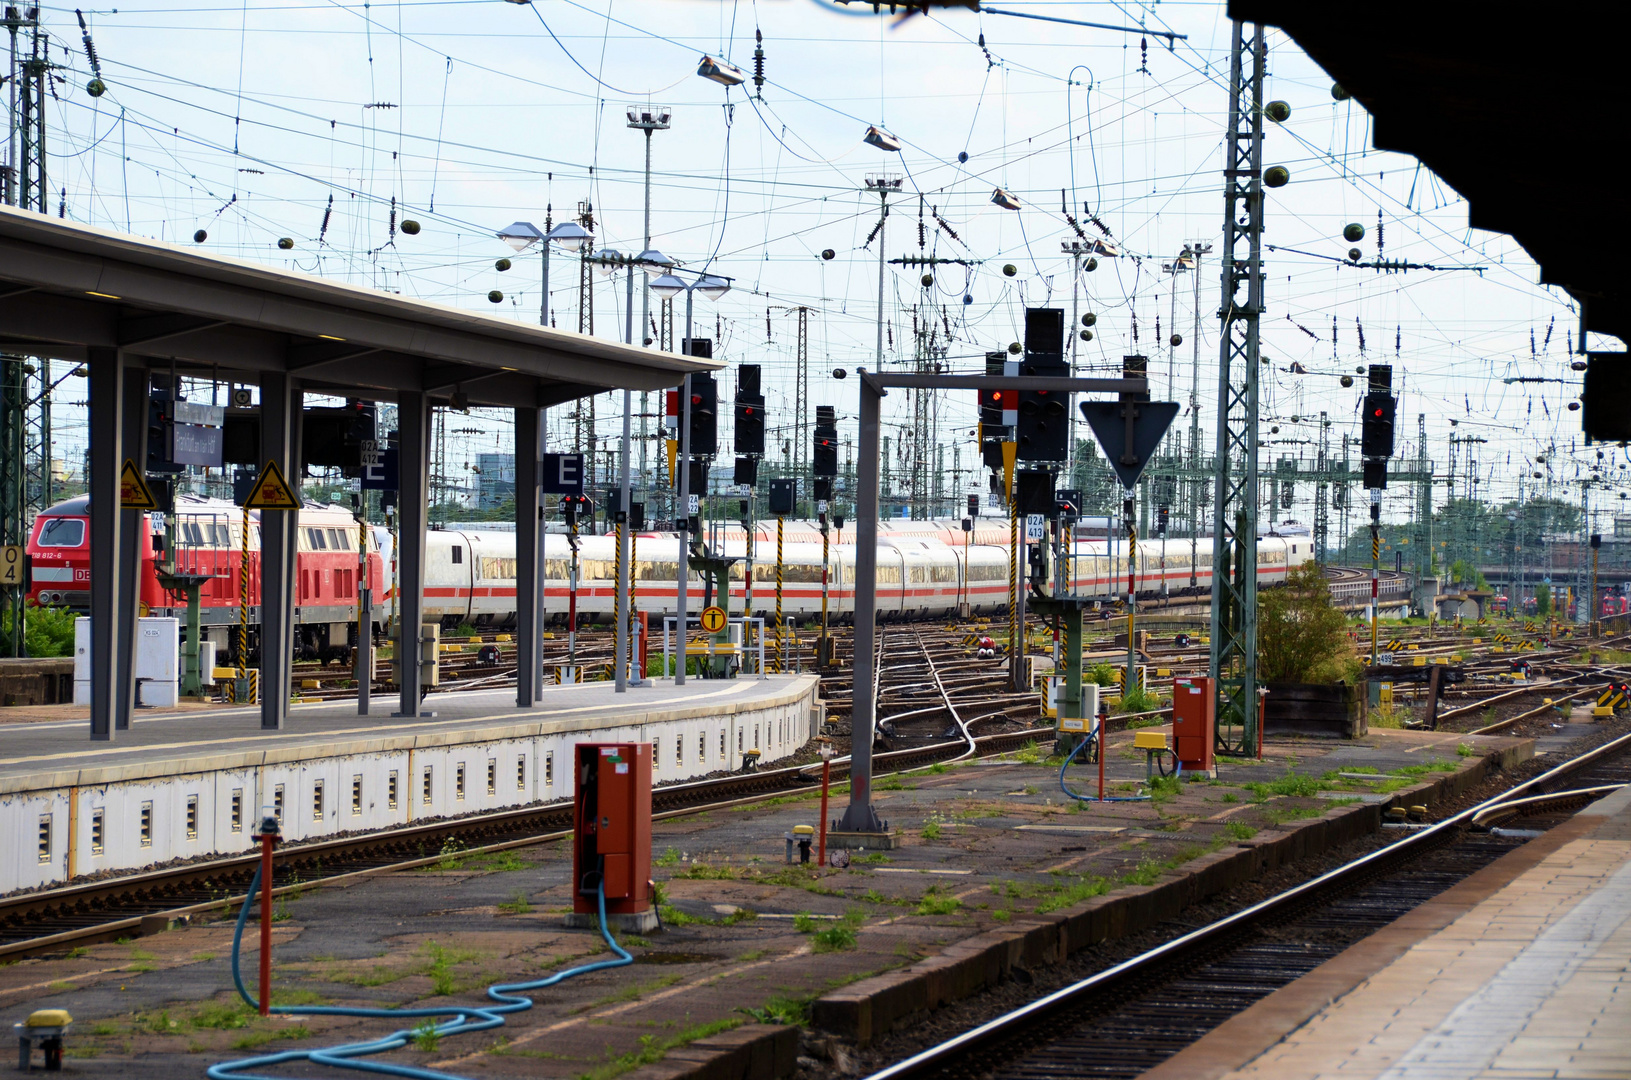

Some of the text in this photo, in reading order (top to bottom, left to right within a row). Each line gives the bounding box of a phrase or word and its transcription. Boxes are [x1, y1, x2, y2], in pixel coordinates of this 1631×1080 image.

[361, 441, 378, 451] 02A
[362, 454, 377, 464] 412
[367, 451, 385, 480] E
[559, 455, 577, 485] E
[689, 495, 698, 503] 2A
[689, 505, 698, 513] 22
[151, 512, 163, 520] 02A
[1028, 515, 1044, 525] 02A
[1028, 529, 1043, 537] 413
[5, 547, 17, 563] 0
[5, 565, 15, 581] 4
[76, 570, 90, 580] DB
[1380, 654, 1392, 663] 499
